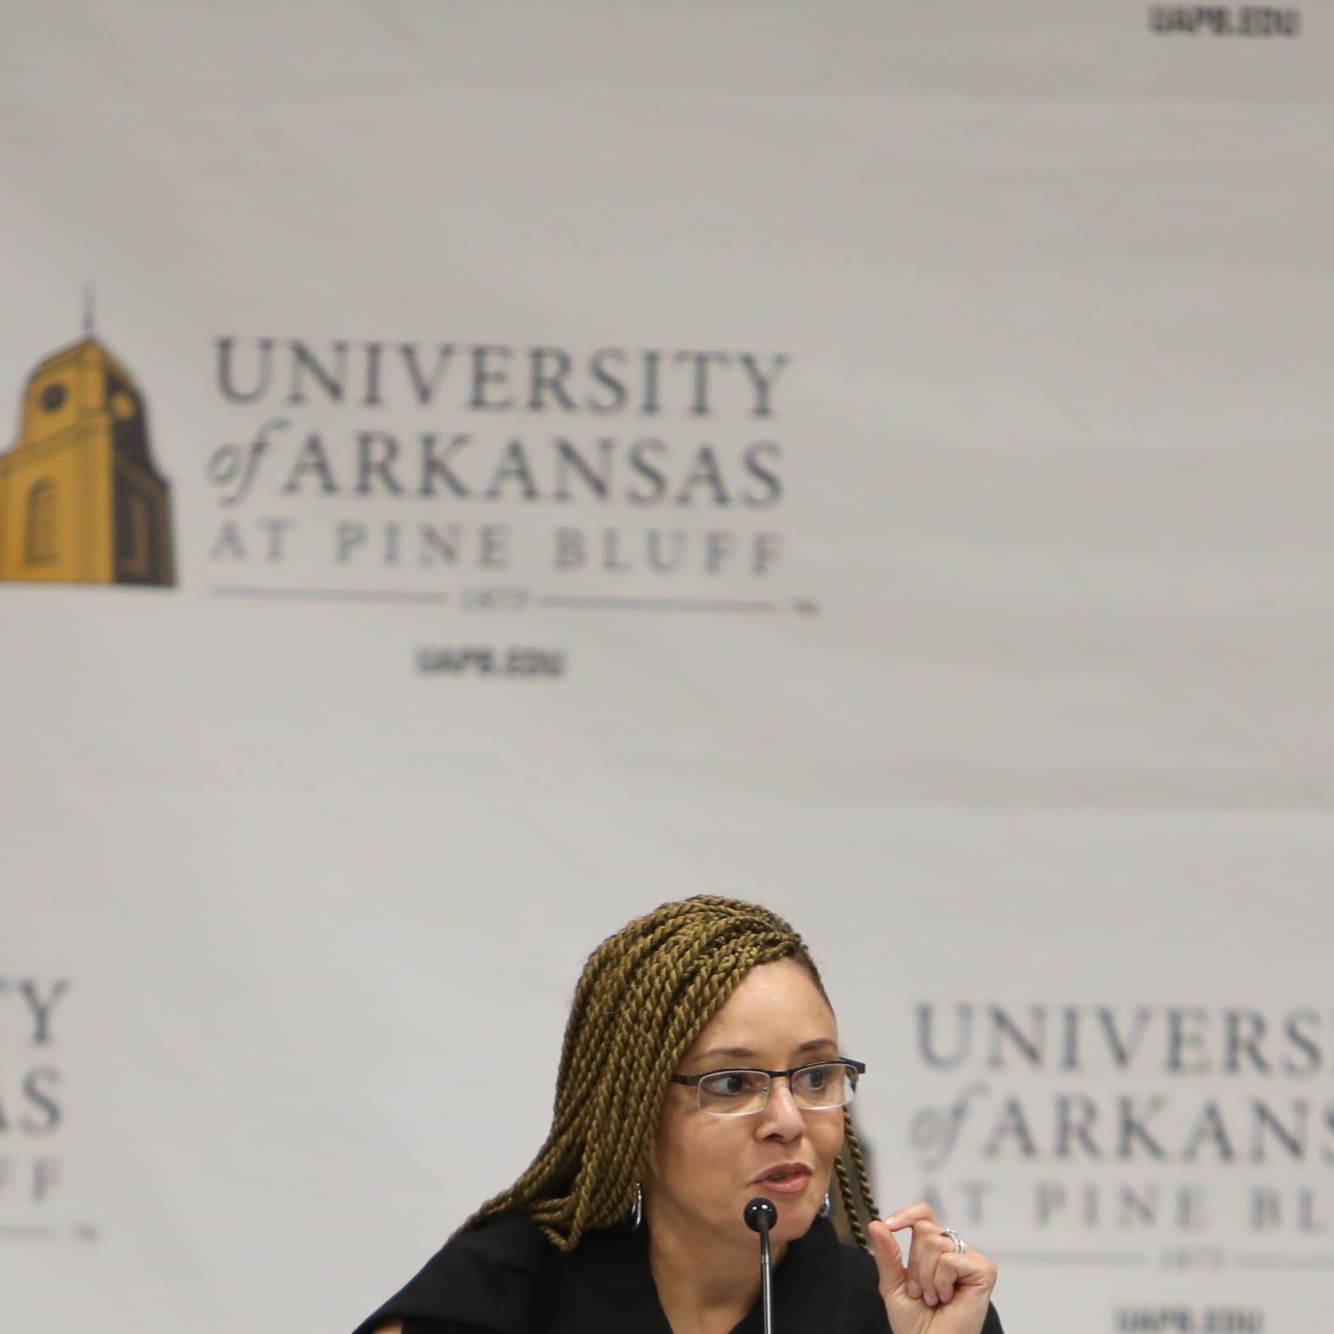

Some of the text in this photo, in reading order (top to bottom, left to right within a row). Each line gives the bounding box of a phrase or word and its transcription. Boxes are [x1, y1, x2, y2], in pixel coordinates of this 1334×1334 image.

[212, 335, 791, 421] UNIVERSITY
[208, 420, 785, 511] of ARKANSAS
[209, 518, 783, 578] AT PINE BLUFF
[908, 1082, 992, 1173] of
[1034, 1183, 1207, 1231] PINE
